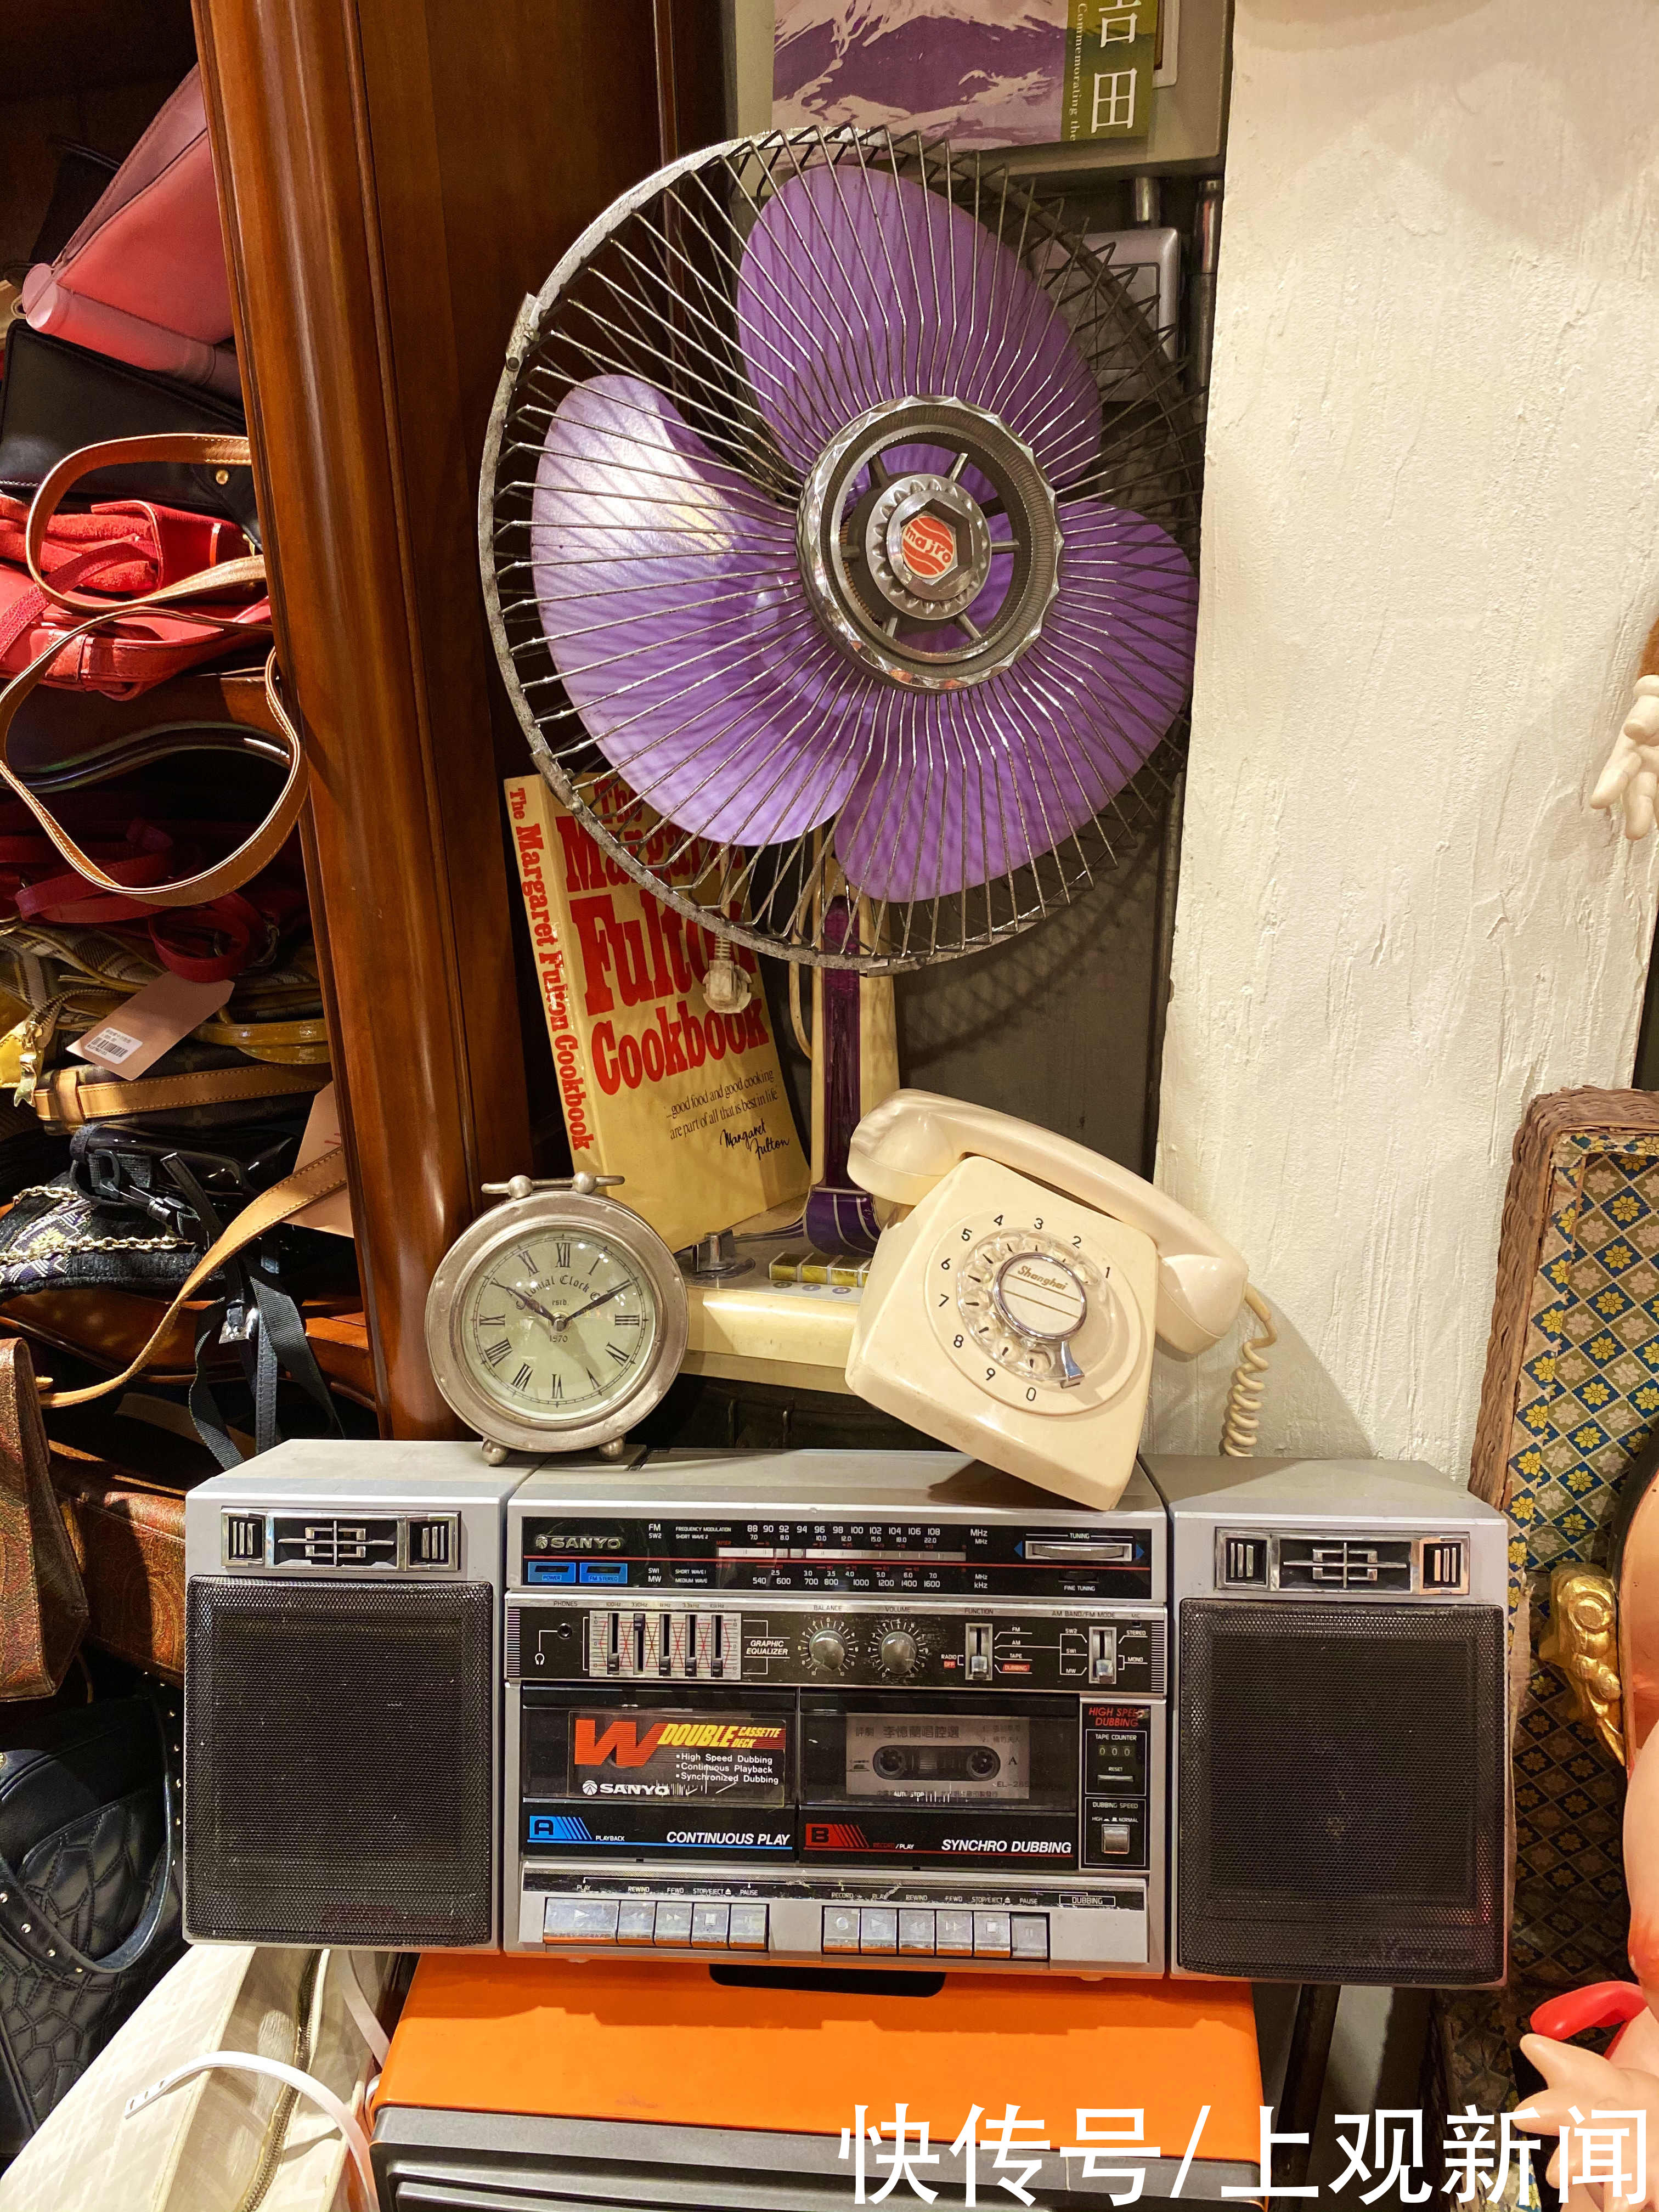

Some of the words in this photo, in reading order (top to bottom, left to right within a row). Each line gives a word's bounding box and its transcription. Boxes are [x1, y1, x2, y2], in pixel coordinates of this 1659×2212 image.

[1069, 3, 1087, 116] Commemorating
[1070, 120, 1080, 141] the
[510, 788, 527, 820] The
[516, 823, 558, 947] Margaret
[539, 950, 569, 1032] Fulton
[591, 998, 769, 1096] Cookbook
[554, 1034, 594, 1150] Cookbook
[691, 1090, 709, 1109] food
[710, 1085, 724, 1102] and
[724, 1077, 743, 1099] good
[743, 1070, 774, 1089] cooking
[670, 1126, 682, 1139] are
[684, 1119, 699, 1138] part
[700, 1112, 708, 1128] of
[709, 1109, 719, 1124] all
[720, 1106, 734, 1120] that
[735, 1103, 742, 1115] is
[741, 1098, 756, 1111] best
[757, 1093, 766, 1107] in
[720, 1118, 766, 1150] Margaret
[750, 1136, 790, 1161] Fulton
[993, 1214, 1003, 1227] 4
[1034, 1217, 1044, 1230] 3
[961, 1228, 972, 1242] 5
[1072, 1235, 1082, 1249] 2
[555, 1243, 571, 1268] XII
[518, 1250, 540, 1277] XI
[941, 1257, 951, 1271] 6
[1017, 1265, 1069, 1291] Shanghai
[1105, 1266, 1111, 1279] 1
[516, 1276, 555, 1310] Clonial
[560, 1274, 590, 1293] Clock
[938, 1293, 950, 1307] 7
[479, 1314, 506, 1327] IX
[614, 1314, 640, 1327] III
[953, 1334, 964, 1348] 8
[484, 1336, 513, 1368] VIII
[586, 1367, 602, 1390] V
[986, 1367, 996, 1381] 9
[551, 1373, 565, 1400] VI
[1026, 1386, 1037, 1402] 0
[747, 1525, 758, 1533] 88
[763, 1525, 774, 1533] 90
[778, 1525, 789, 1533] 92
[797, 1525, 808, 1534] 94
[814, 1526, 825, 1534] 96
[832, 1526, 844, 1534] 98
[850, 1526, 864, 1534] 100
[869, 1527, 882, 1535] 102
[888, 1527, 901, 1536] 104
[908, 1527, 921, 1536] 106
[927, 1528, 940, 1536] 108
[970, 1528, 988, 1537] MHz
[550, 1537, 622, 1549] SANYO
[752, 1577, 766, 1585] 540
[853, 1578, 870, 1587] 1000
[878, 1579, 895, 1587] 1200
[901, 1579, 917, 1588] 1400
[923, 1580, 941, 1588] 1600
[974, 1581, 988, 1589] kHz
[750, 1640, 785, 1648] GRAPHIC
[746, 1647, 788, 1656] EQUALIZER
[1088, 1707, 1114, 1717] HIGH
[1095, 1717, 1139, 1728] DUBBING
[657, 1723, 740, 1747] DOUBLE
[738, 1726, 782, 1738] CASSETTE
[731, 1737, 757, 1748] DECK
[681, 1753, 701, 1762] High
[705, 1754, 733, 1764] Speed
[737, 1755, 773, 1765] Dubbing
[1008, 1756, 1018, 1765] A
[681, 1763, 730, 1772] Continuous
[734, 1764, 773, 1776] Playback
[681, 1772, 739, 1783] Synchronized
[743, 1775, 779, 1785] Dubbing
[600, 1783, 670, 1796] SANYO
[534, 1819, 554, 1836] A
[667, 1831, 754, 1845] CONTINUOUS
[757, 1834, 791, 1846] PLAY
[811, 1827, 830, 1843] B
[941, 1839, 1007, 1852] SYNCHRO
[1011, 1841, 1072, 1854] DUBBING
[693, 1887, 724, 1895] STOP/EJECT
[972, 1896, 1003, 1904] STOP/EJECT
